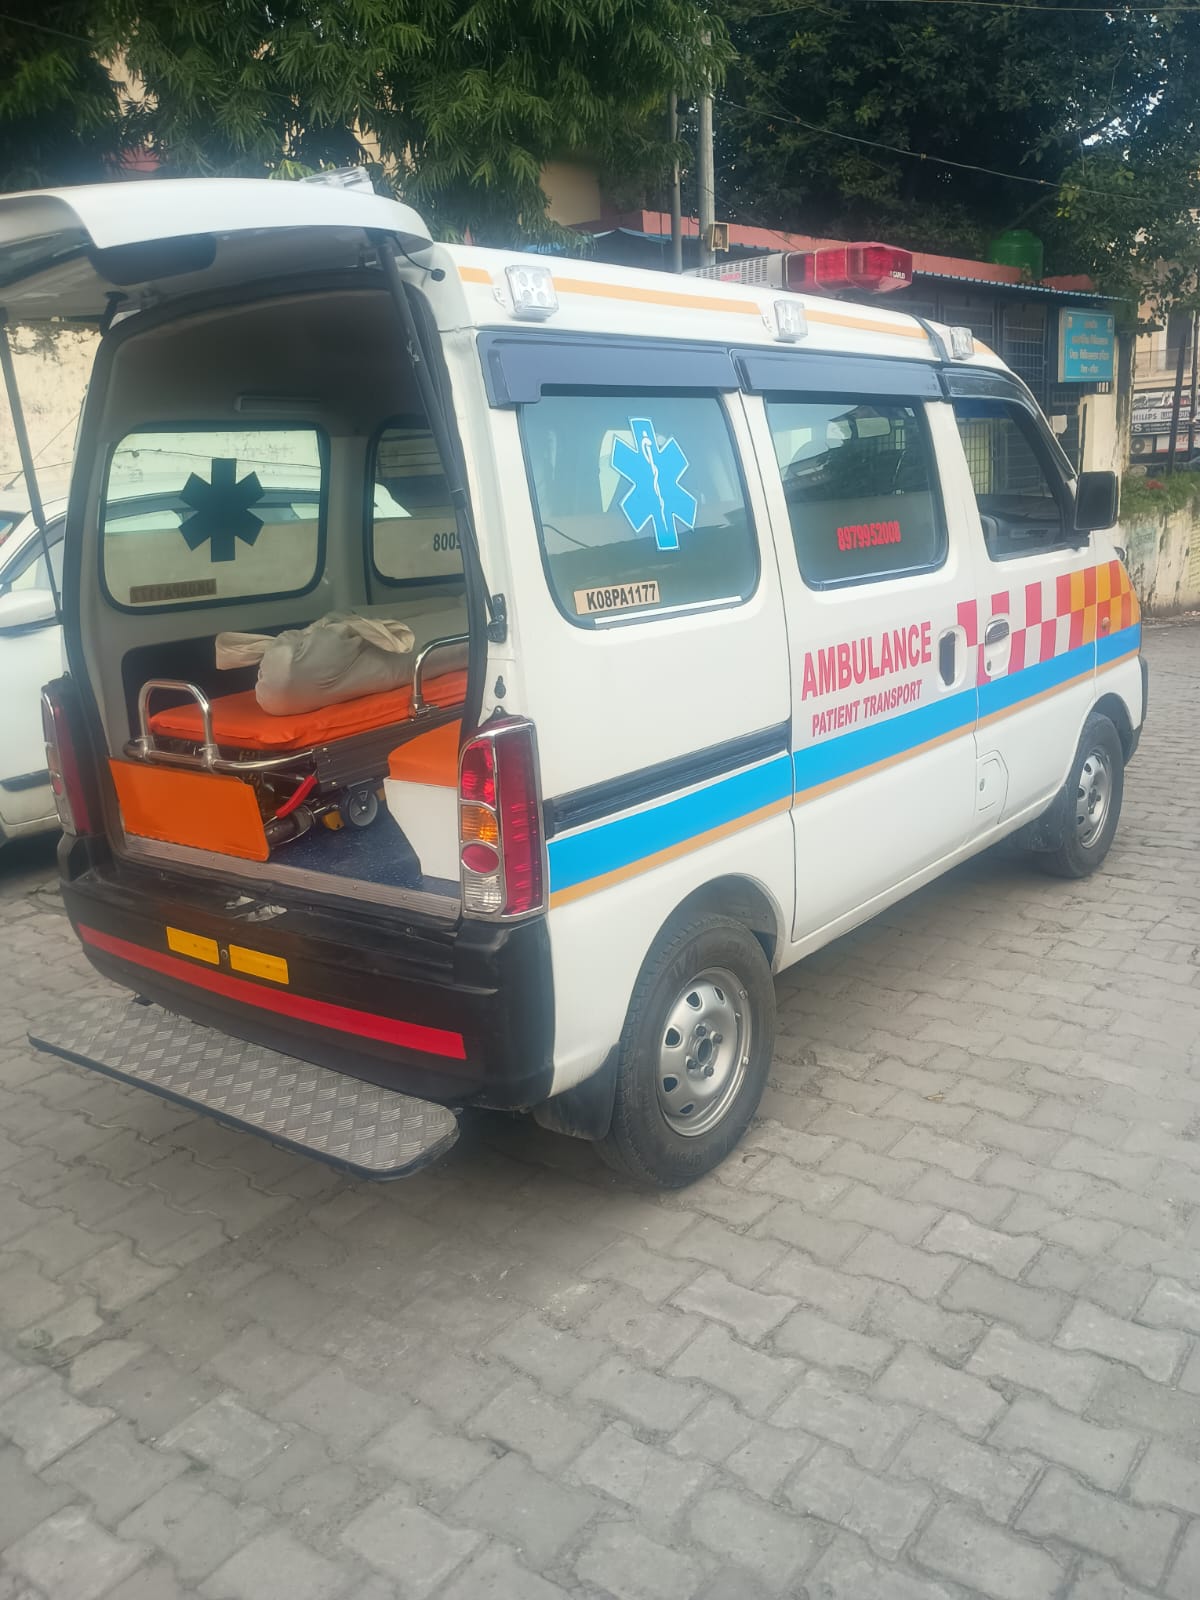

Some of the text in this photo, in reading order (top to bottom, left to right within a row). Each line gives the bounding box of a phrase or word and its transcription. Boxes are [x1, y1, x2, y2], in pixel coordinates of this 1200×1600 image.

[1132, 413, 1158, 422] HILIPS
[586, 583, 656, 611] K08PA1177
[801, 621, 932, 701] AMBULANCE
[811, 679, 923, 738] PATIENT TRANSPORT
